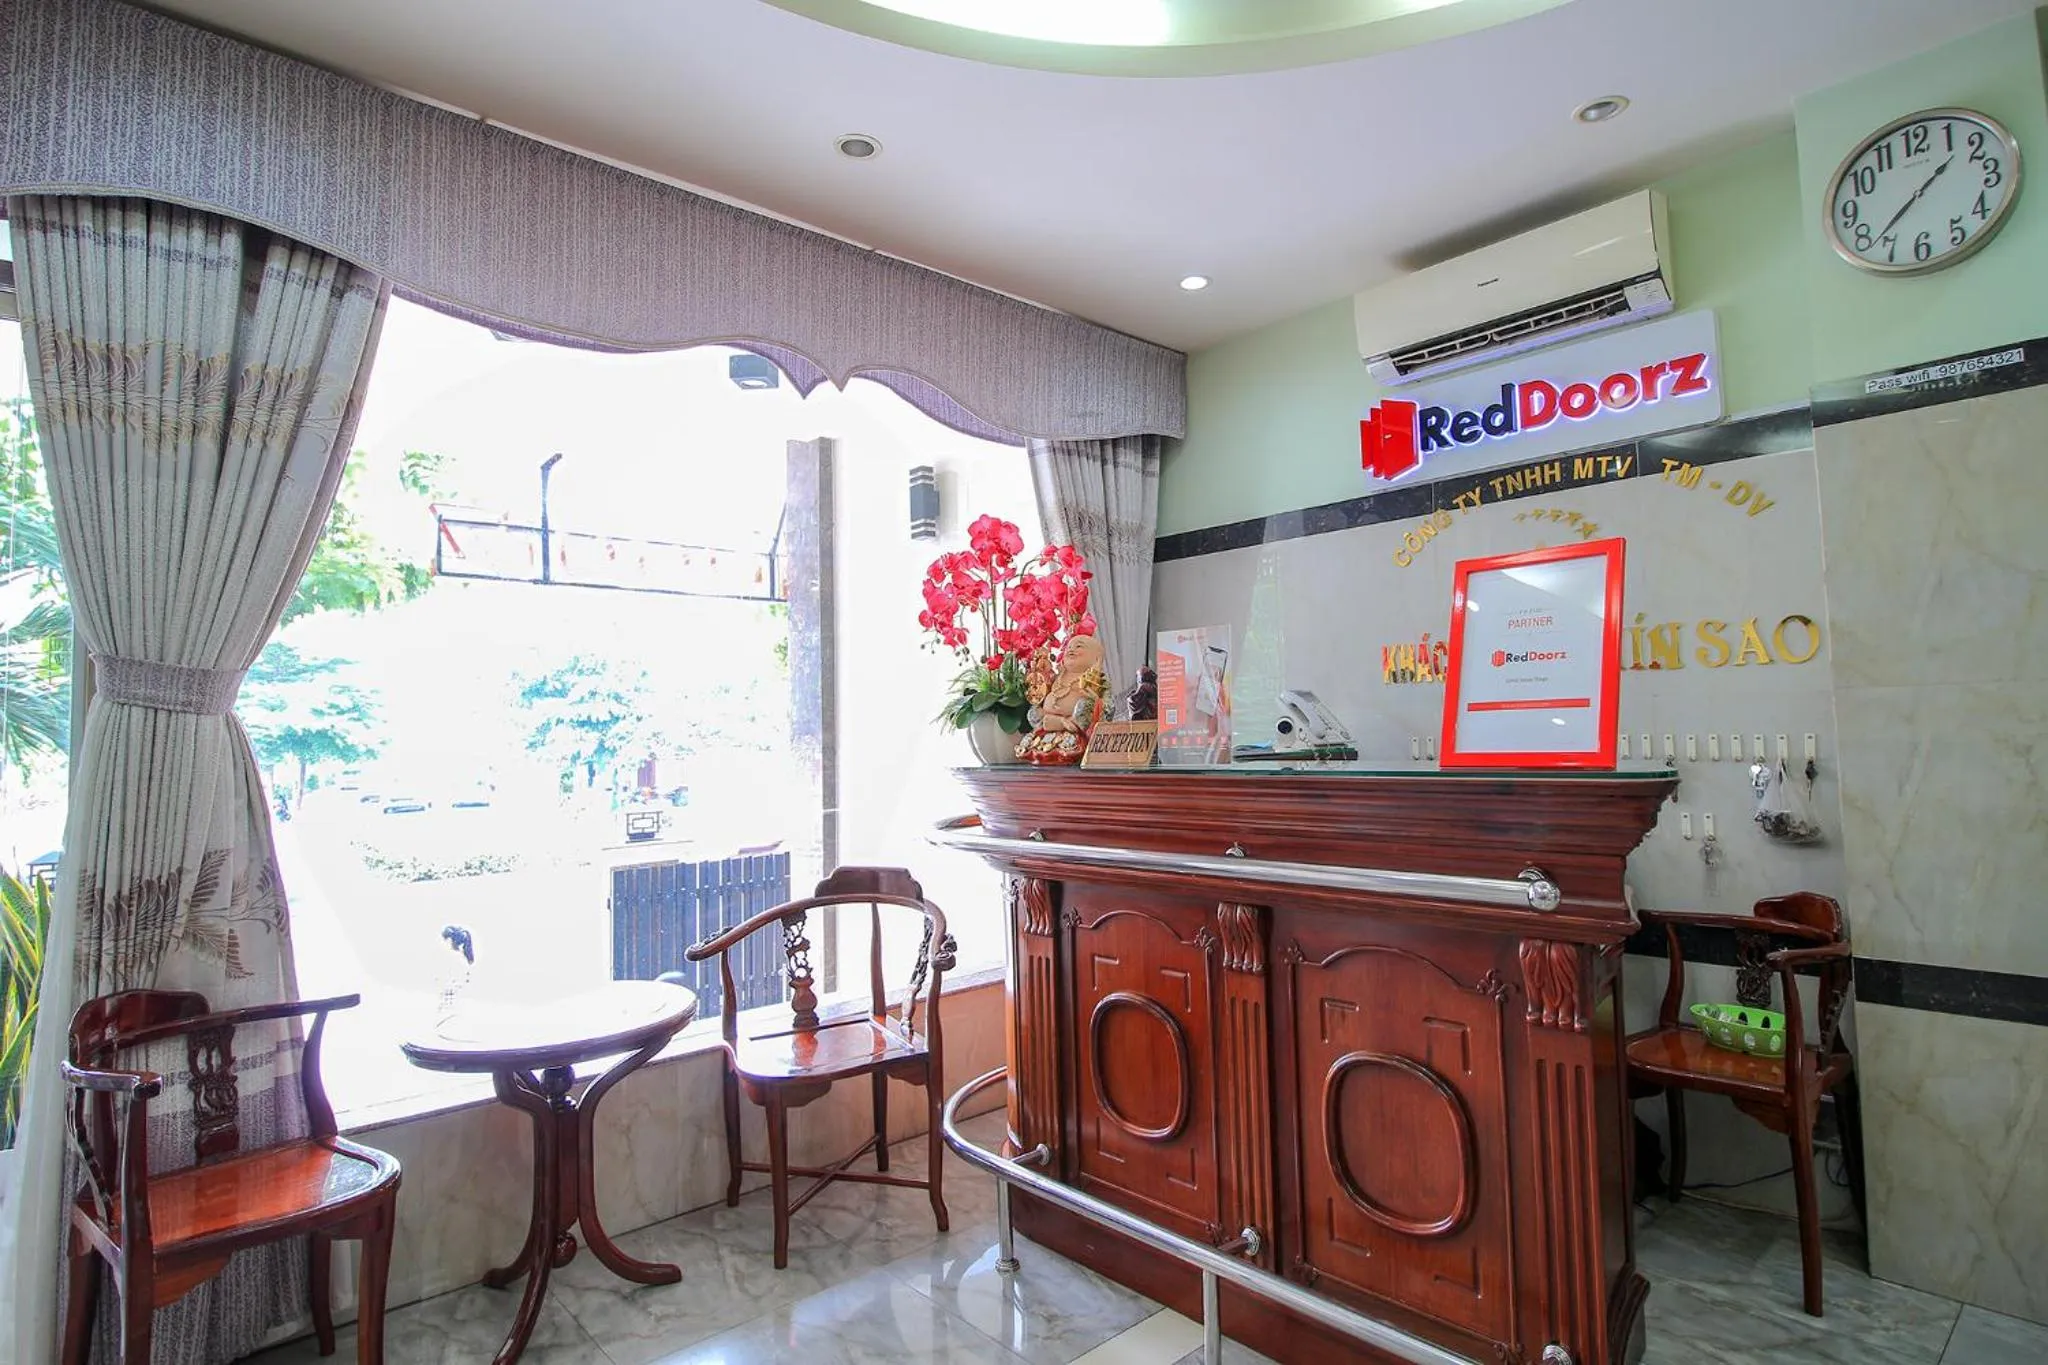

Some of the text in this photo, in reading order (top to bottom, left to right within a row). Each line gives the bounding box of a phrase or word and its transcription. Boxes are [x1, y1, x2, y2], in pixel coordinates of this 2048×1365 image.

[1901, 125, 1930, 157] 12
[1942, 122, 1953, 152] 1
[1968, 132, 1986, 163] 2
[1873, 142, 1893, 173] 11
[1983, 158, 2001, 187] 3
[1849, 166, 1876, 197] 10
[1842, 200, 1858, 228] 9
[1971, 190, 1991, 220] 4
[1855, 223, 1872, 252] 8
[1950, 215, 1966, 245] 5
[1882, 233, 1897, 262] 7
[1914, 231, 1931, 261] 6
[1868, 377, 1903, 393] Pass
[1906, 369, 1930, 384] wifi
[1419, 352, 1709, 452] RedDoorz
[1489, 462, 1562, 500] TNHH
[1573, 455, 1633, 481] MTV
[1661, 457, 1704, 491] TM
[1725, 479, 1776, 518] DV
[1507, 615, 1553, 630] PARTNER
[1382, 612, 1821, 685] KHÁC ÍN SAO
[1506, 650, 1568, 664] RedDoorz
[1090, 732, 1155, 754] RECEPTION
